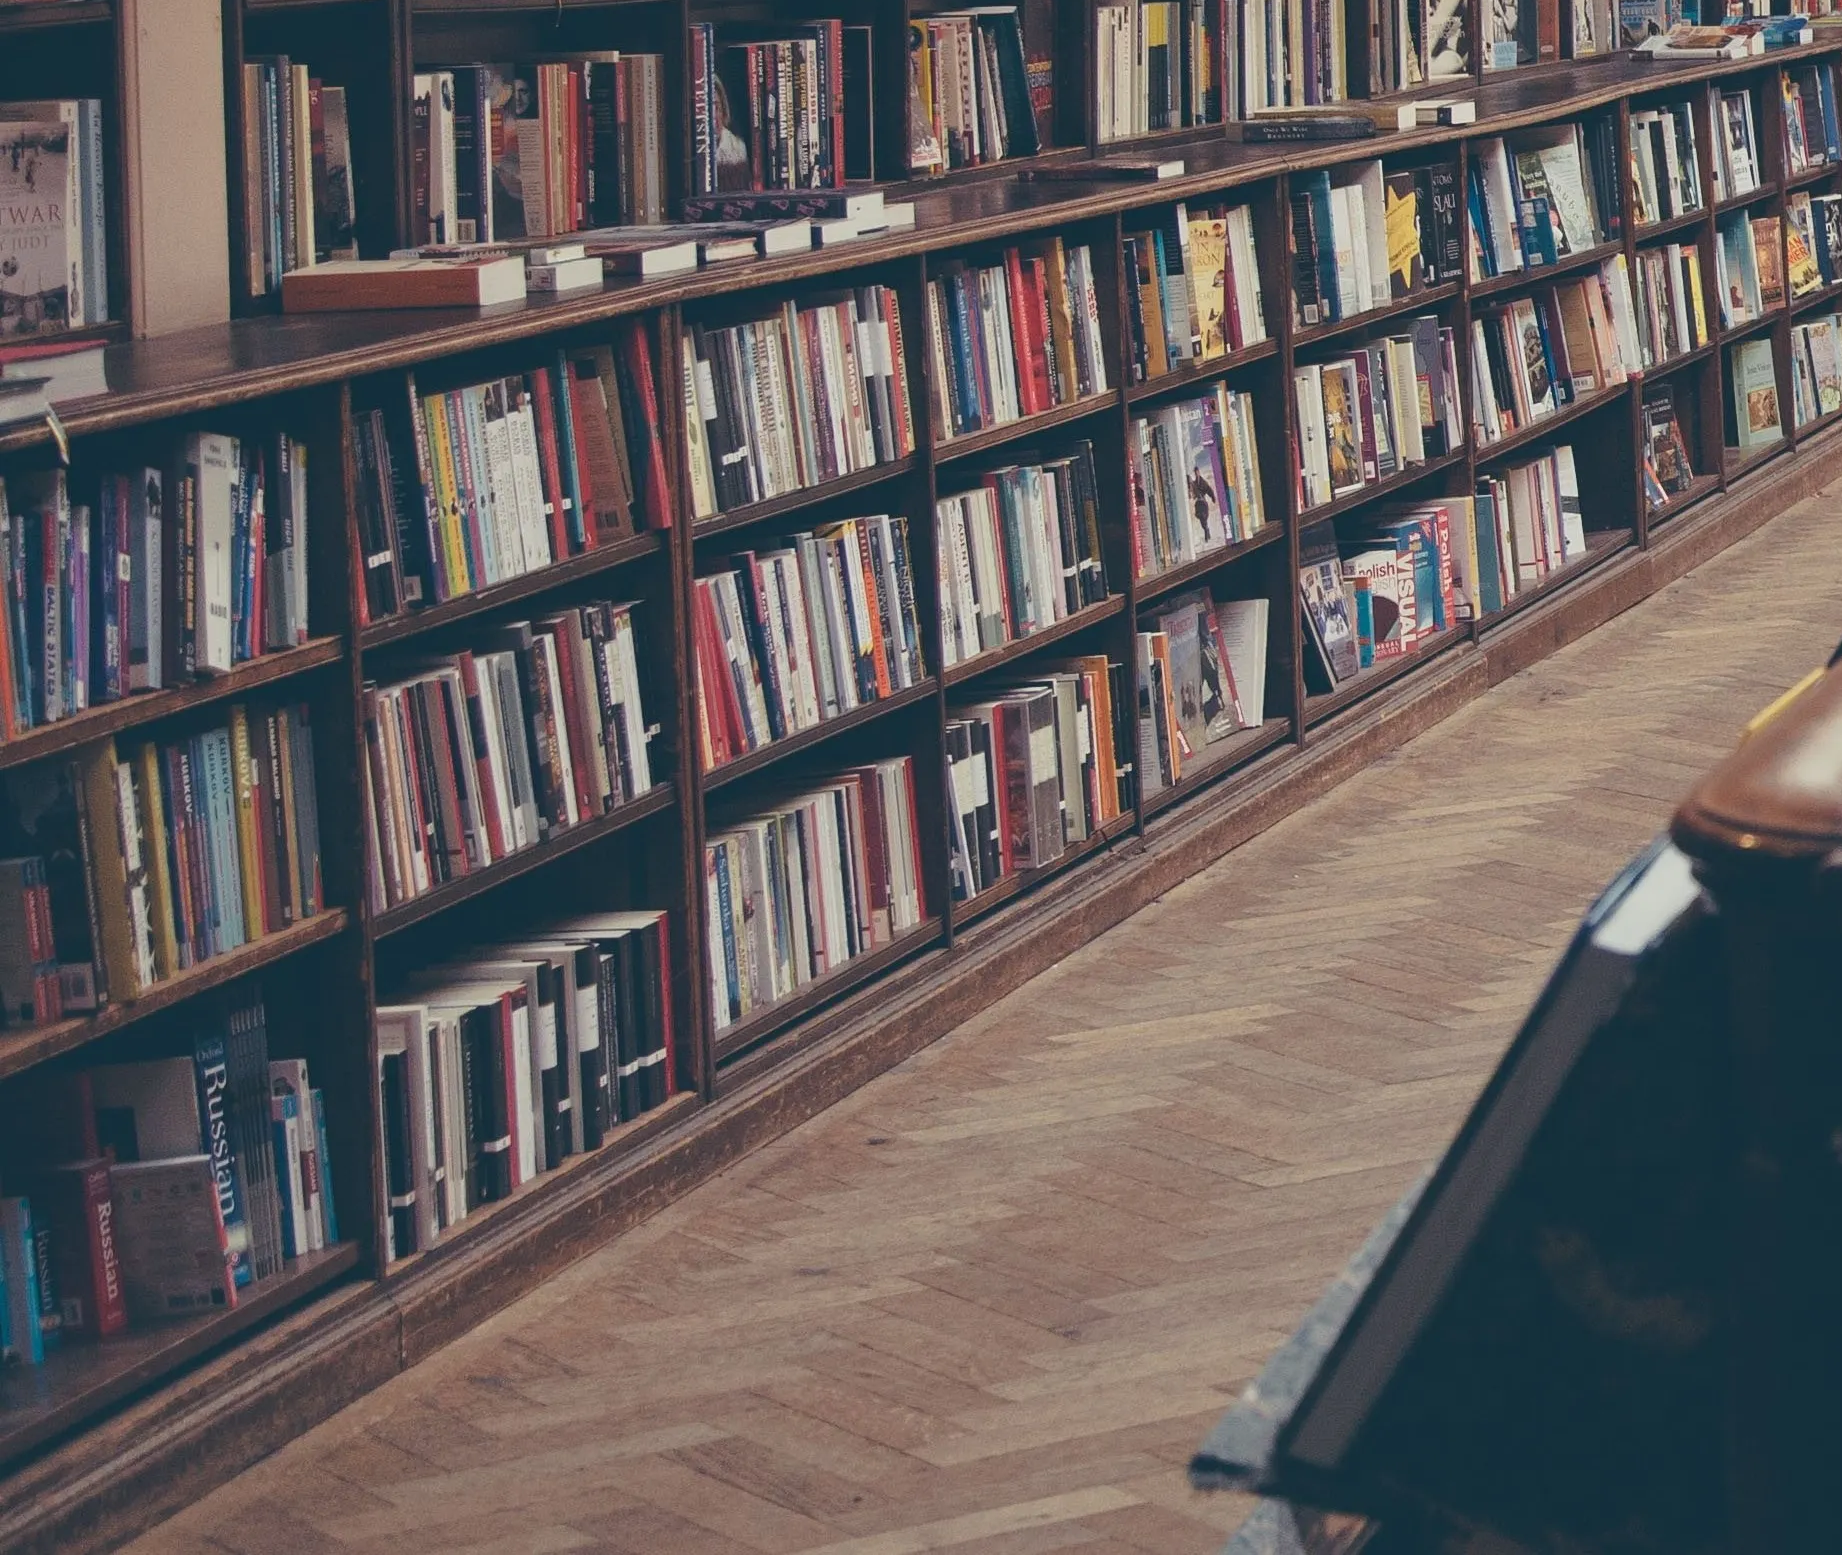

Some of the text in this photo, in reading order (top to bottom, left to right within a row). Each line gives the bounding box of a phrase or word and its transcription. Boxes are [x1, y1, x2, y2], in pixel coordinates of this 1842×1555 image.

[695, 76, 707, 155] YELTSIN
[779, 62, 788, 139] STRONGMAN
[12, 234, 50, 249] JUDT
[409, 385, 423, 431] Selected
[956, 522, 968, 564] AGENT
[1438, 527, 1453, 593] Polish
[1397, 551, 1418, 652] VISUAL
[46, 586, 57, 697] BALTIC STATES
[181, 753, 193, 813] KURKOV
[207, 742, 219, 801] KURKOV
[219, 737, 231, 795] KURKOV
[238, 714, 251, 788] KURKOV
[718, 858, 733, 931] Sashenka
[205, 1062, 237, 1216] Russian
[36, 1229, 54, 1311] Russian
[97, 1200, 120, 1304] Russian
